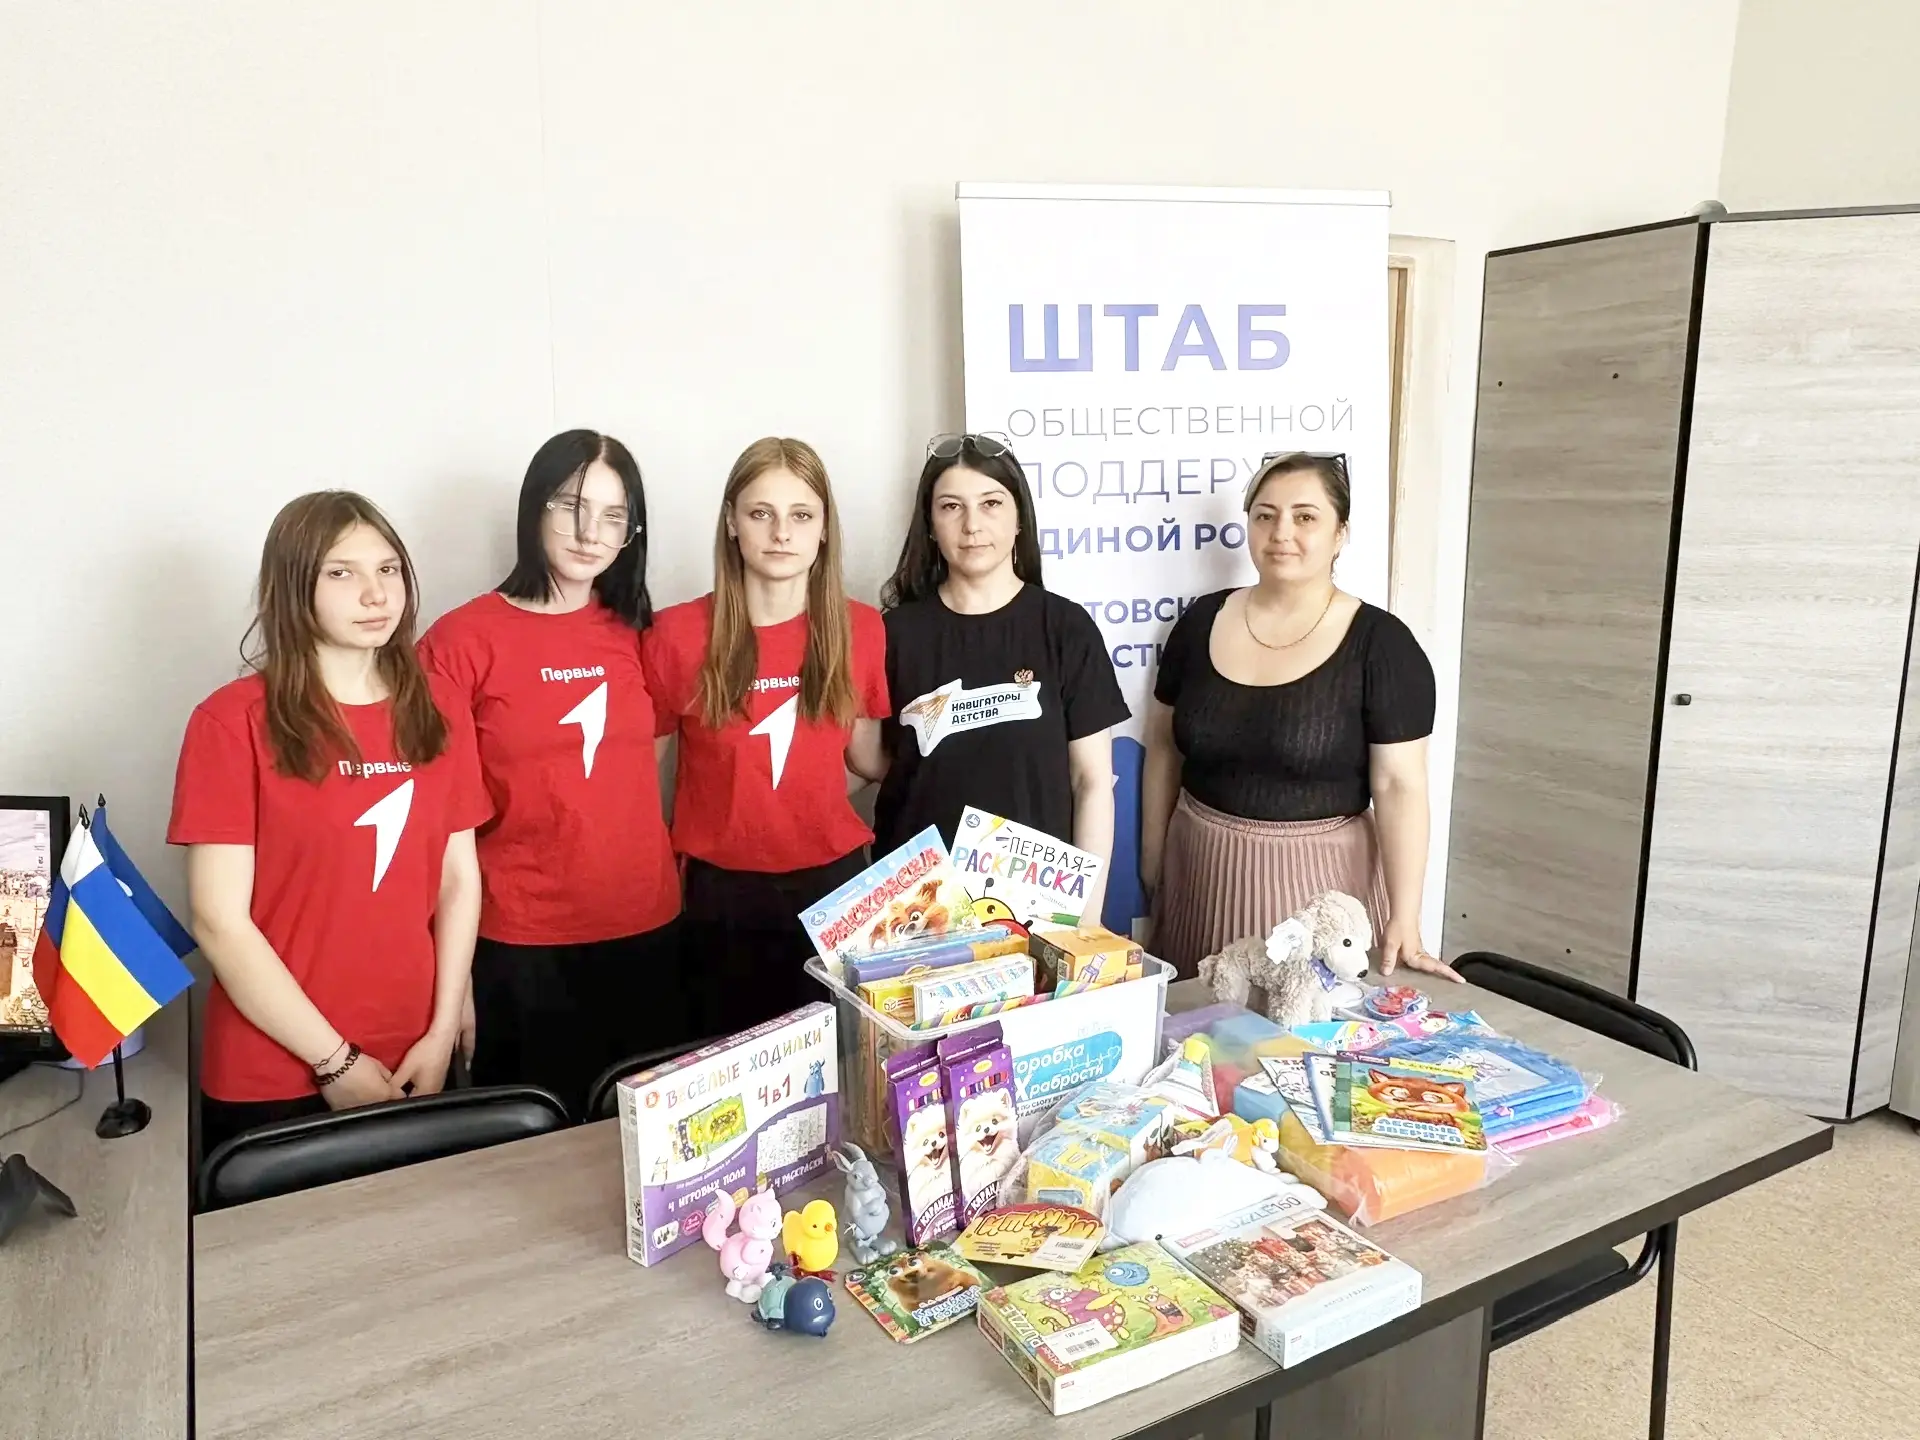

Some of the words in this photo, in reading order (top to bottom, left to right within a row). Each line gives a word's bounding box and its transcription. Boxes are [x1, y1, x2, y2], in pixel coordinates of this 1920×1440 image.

[1008, 303, 1291, 373] ШТАБ
[1007, 398, 1354, 441] ОБЩЕСТВЕННОЙ
[1020, 457, 1256, 504] ПОДДЕР
[1039, 517, 1181, 560] ДИНОЙ
[540, 663, 605, 684] Первые
[748, 675, 800, 694] ервые
[951, 692, 1021, 712] НАВИГАТОРЫ
[951, 707, 999, 725] ДЕТСТВА
[952, 845, 1085, 899] РАСКРАСКА
[1009, 836, 1085, 873] ПЕРВАЯ
[818, 847, 942, 951] РАСКРАСКА
[749, 1028, 822, 1072] ХОДИЛКИ
[1375, 1124, 1463, 1144] ЗВЕРЯТА
[1378, 1118, 1458, 1135] ЛЕСНЫЕ
[678, 1179, 720, 1209] ИГРОВЫХ
[723, 1167, 746, 1186] ПОЛЯ
[781, 1156, 824, 1186] РАСКРАСКИ
[919, 1193, 955, 1227] КАРАНДА
[970, 1181, 999, 1210] КАРАН
[999, 1304, 1045, 1348] PUZZLE
